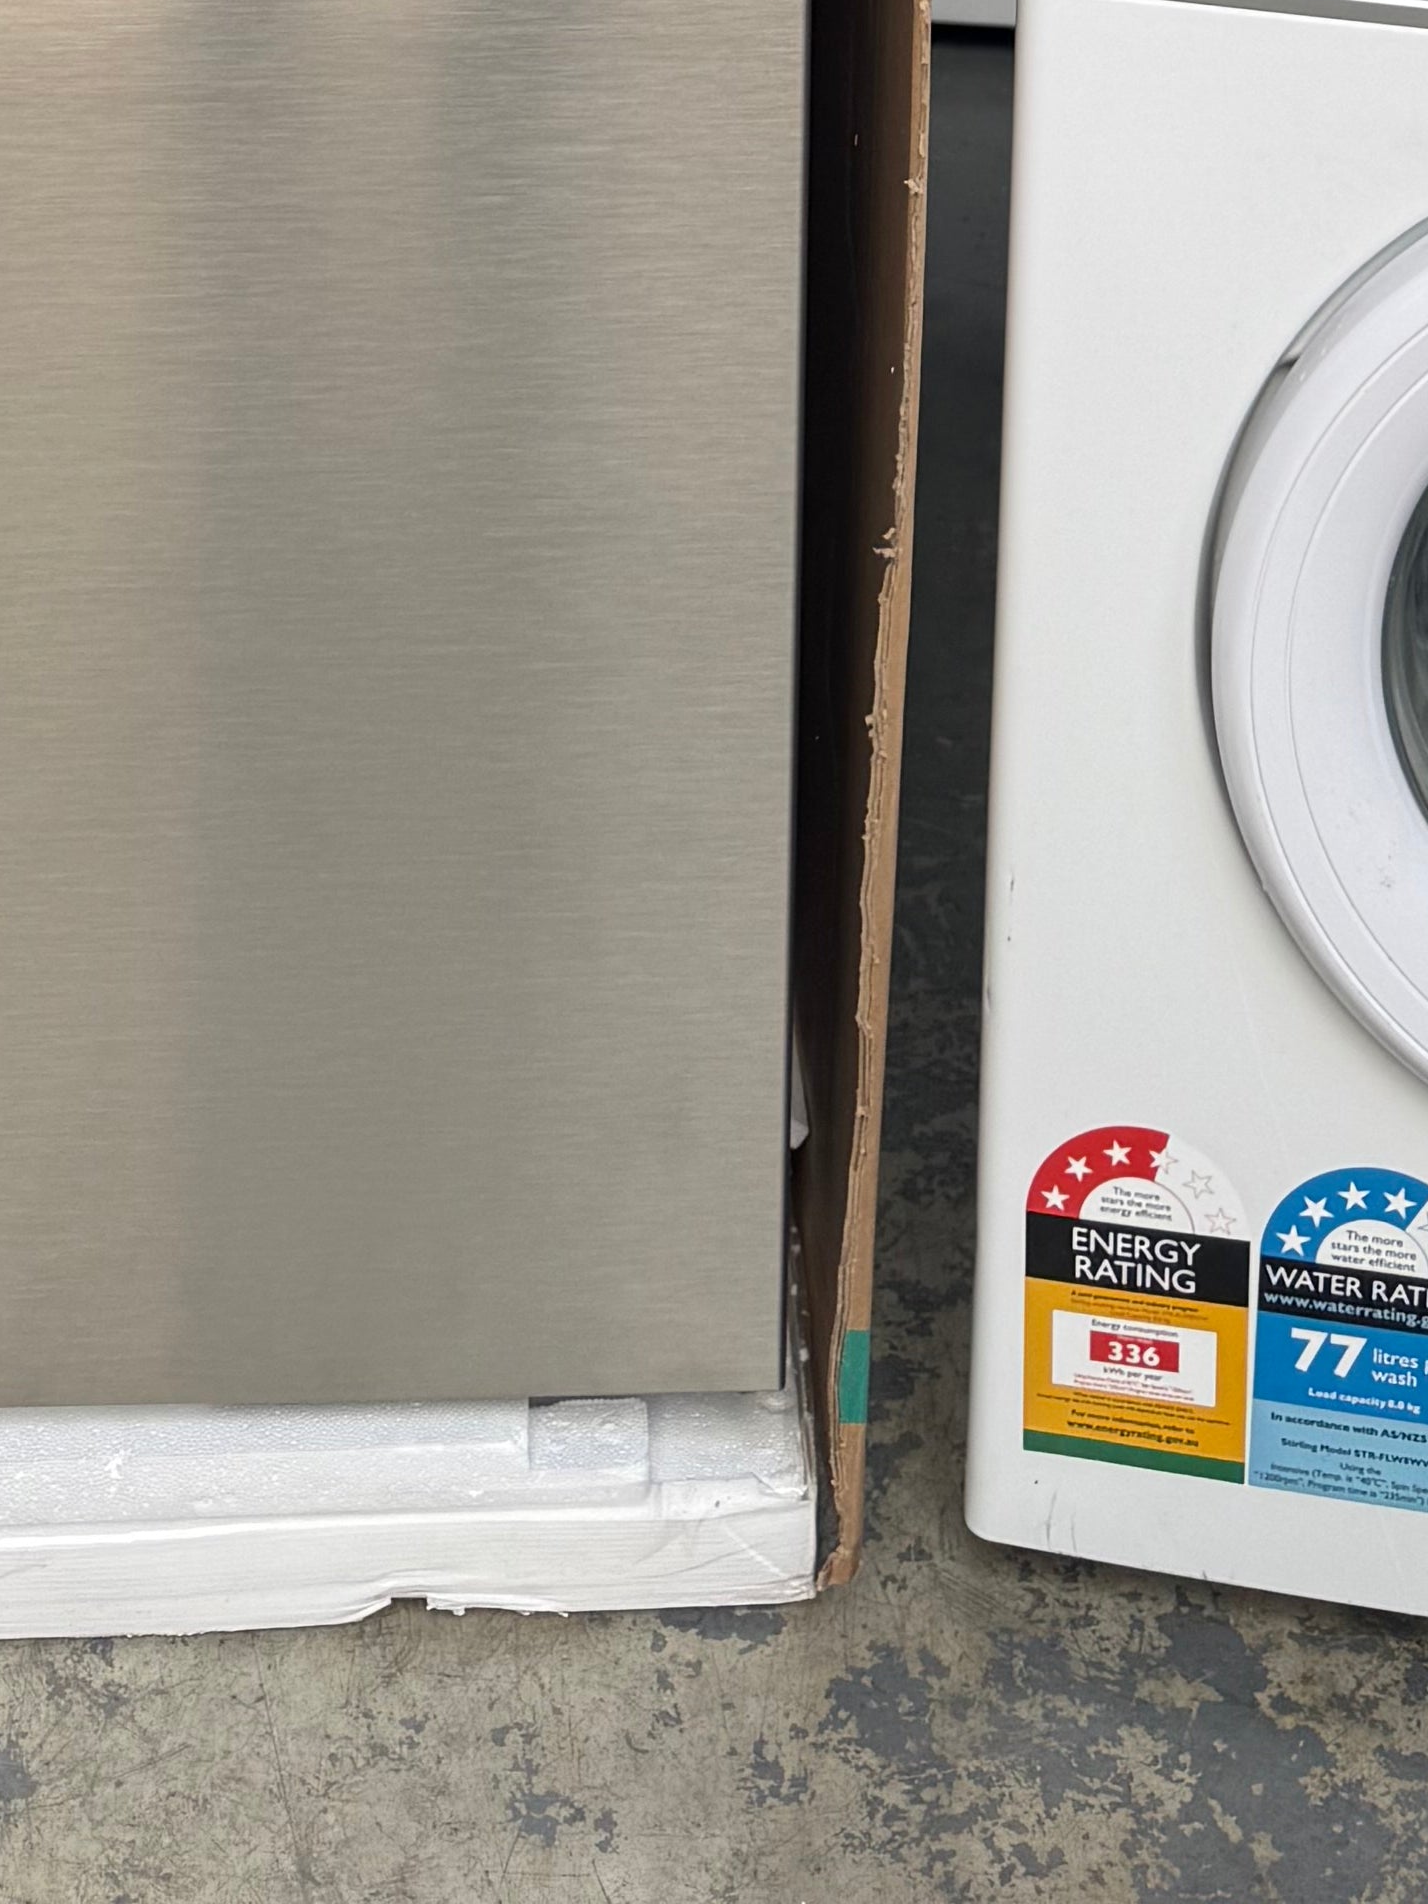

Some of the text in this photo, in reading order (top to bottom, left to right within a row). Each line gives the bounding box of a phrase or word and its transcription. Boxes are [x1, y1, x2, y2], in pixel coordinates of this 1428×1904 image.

[1114, 1186, 1160, 1200] The more
[1101, 1196, 1171, 1211] stars the more
[1100, 1206, 1172, 1221] energy efficient
[1073, 1227, 1201, 1265] ENERGY
[1346, 1230, 1403, 1247] The more
[1331, 1242, 1416, 1260] stars the more
[1332, 1254, 1415, 1272] water efficient
[1075, 1255, 1196, 1293] RATING
[1266, 1264, 1362, 1299] WATER
[1092, 1319, 1178, 1337] Energy consumption
[1108, 1341, 1160, 1366] 336
[1291, 1327, 1367, 1378] 77
[1373, 1348, 1418, 1369] litres
[1103, 1367, 1162, 1382] kWh per year
[1372, 1369, 1417, 1387] wash
[1308, 1387, 1336, 1400] Load
[1338, 1394, 1386, 1409] capacity
[1407, 1403, 1420, 1414] kg
[1067, 1421, 1199, 1447] www.energyrating.gov.au
[1271, 1412, 1282, 1421] In
[1285, 1415, 1350, 1432] accordance
[1353, 1426, 1378, 1436] with
[1381, 1429, 1427, 1443] AS/NZS
[1281, 1438, 1317, 1453] Stirling
[1320, 1444, 1351, 1456] Model
[1271, 1463, 1309, 1476] Intensive
[1340, 1462, 1381, 1476] Using the
[1307, 1479, 1345, 1493] Program
